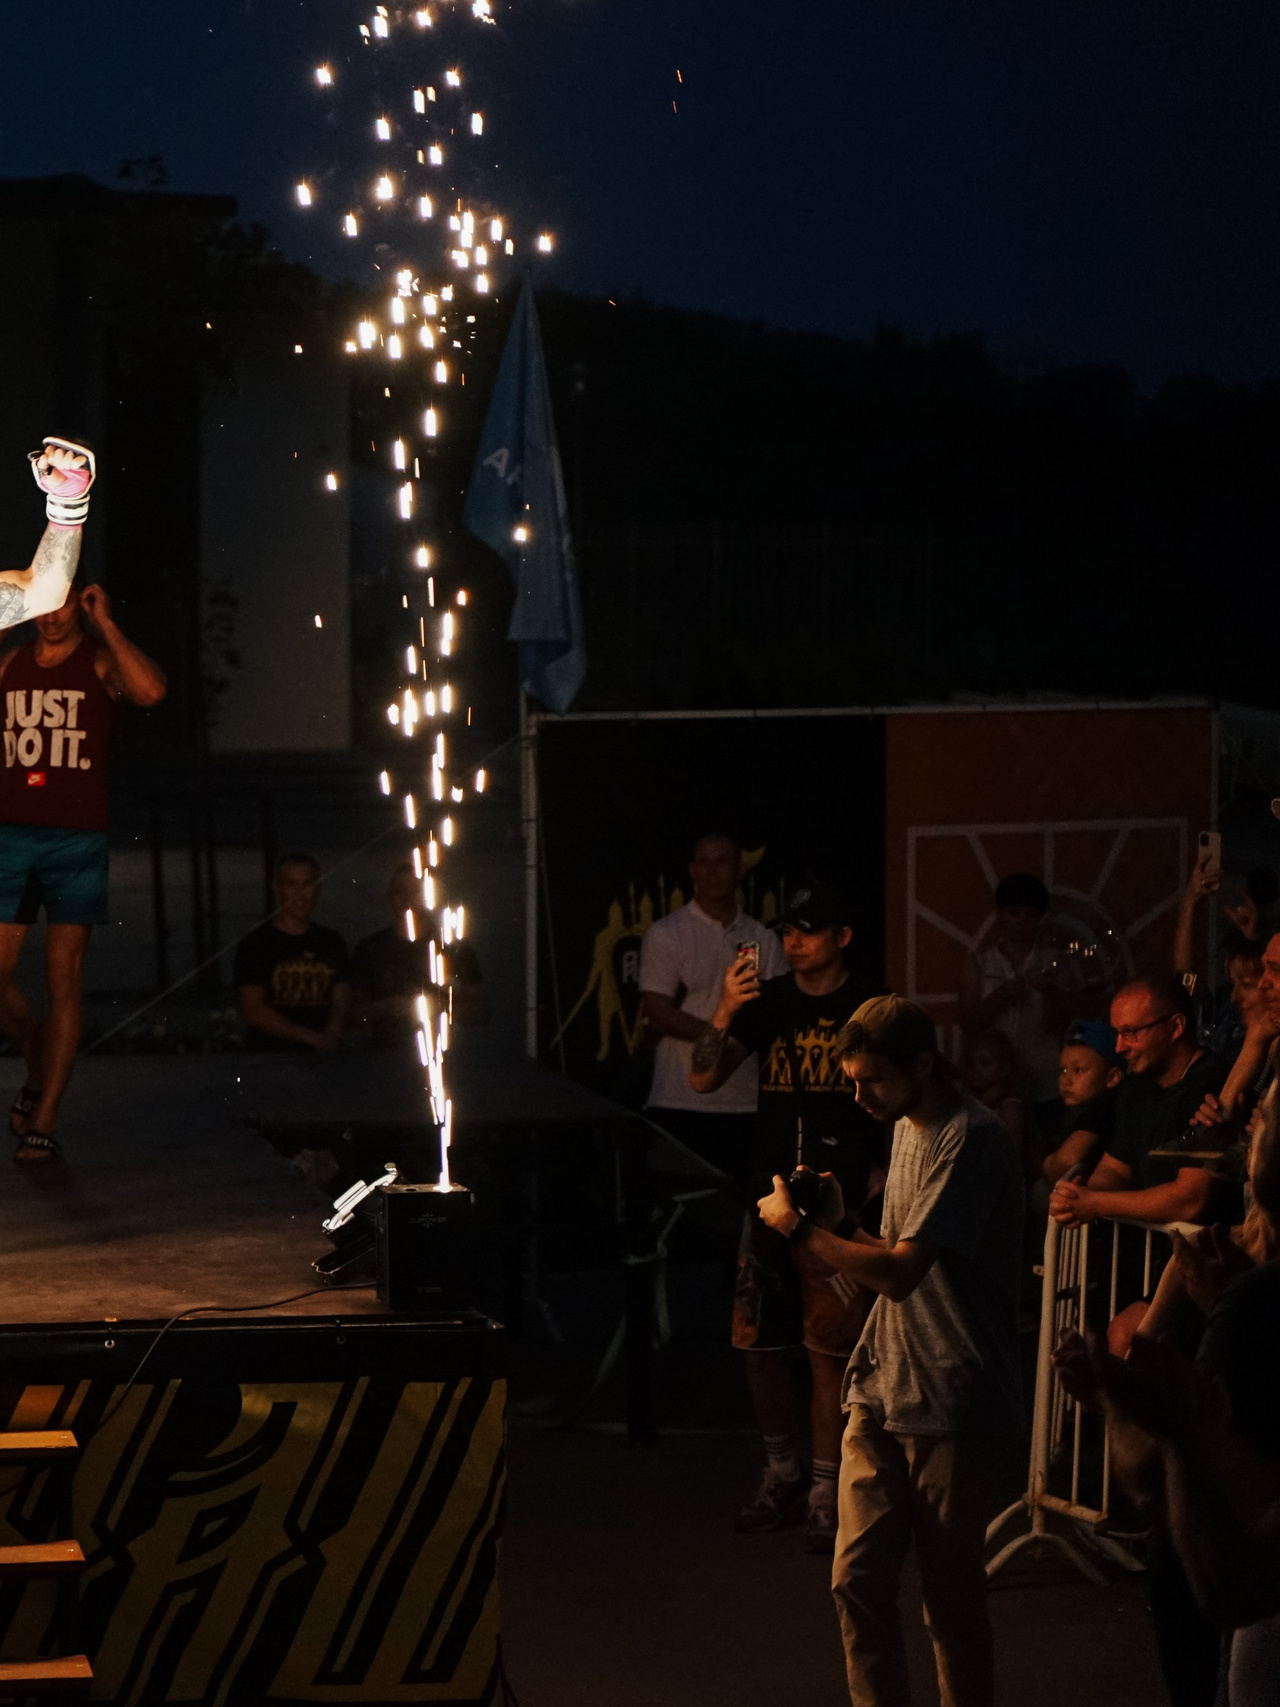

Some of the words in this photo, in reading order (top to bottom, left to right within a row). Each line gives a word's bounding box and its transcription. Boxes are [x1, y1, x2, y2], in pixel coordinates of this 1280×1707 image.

[5, 689, 86, 730] JUST
[3, 727, 43, 768] DO
[50, 729, 91, 770] IT.
